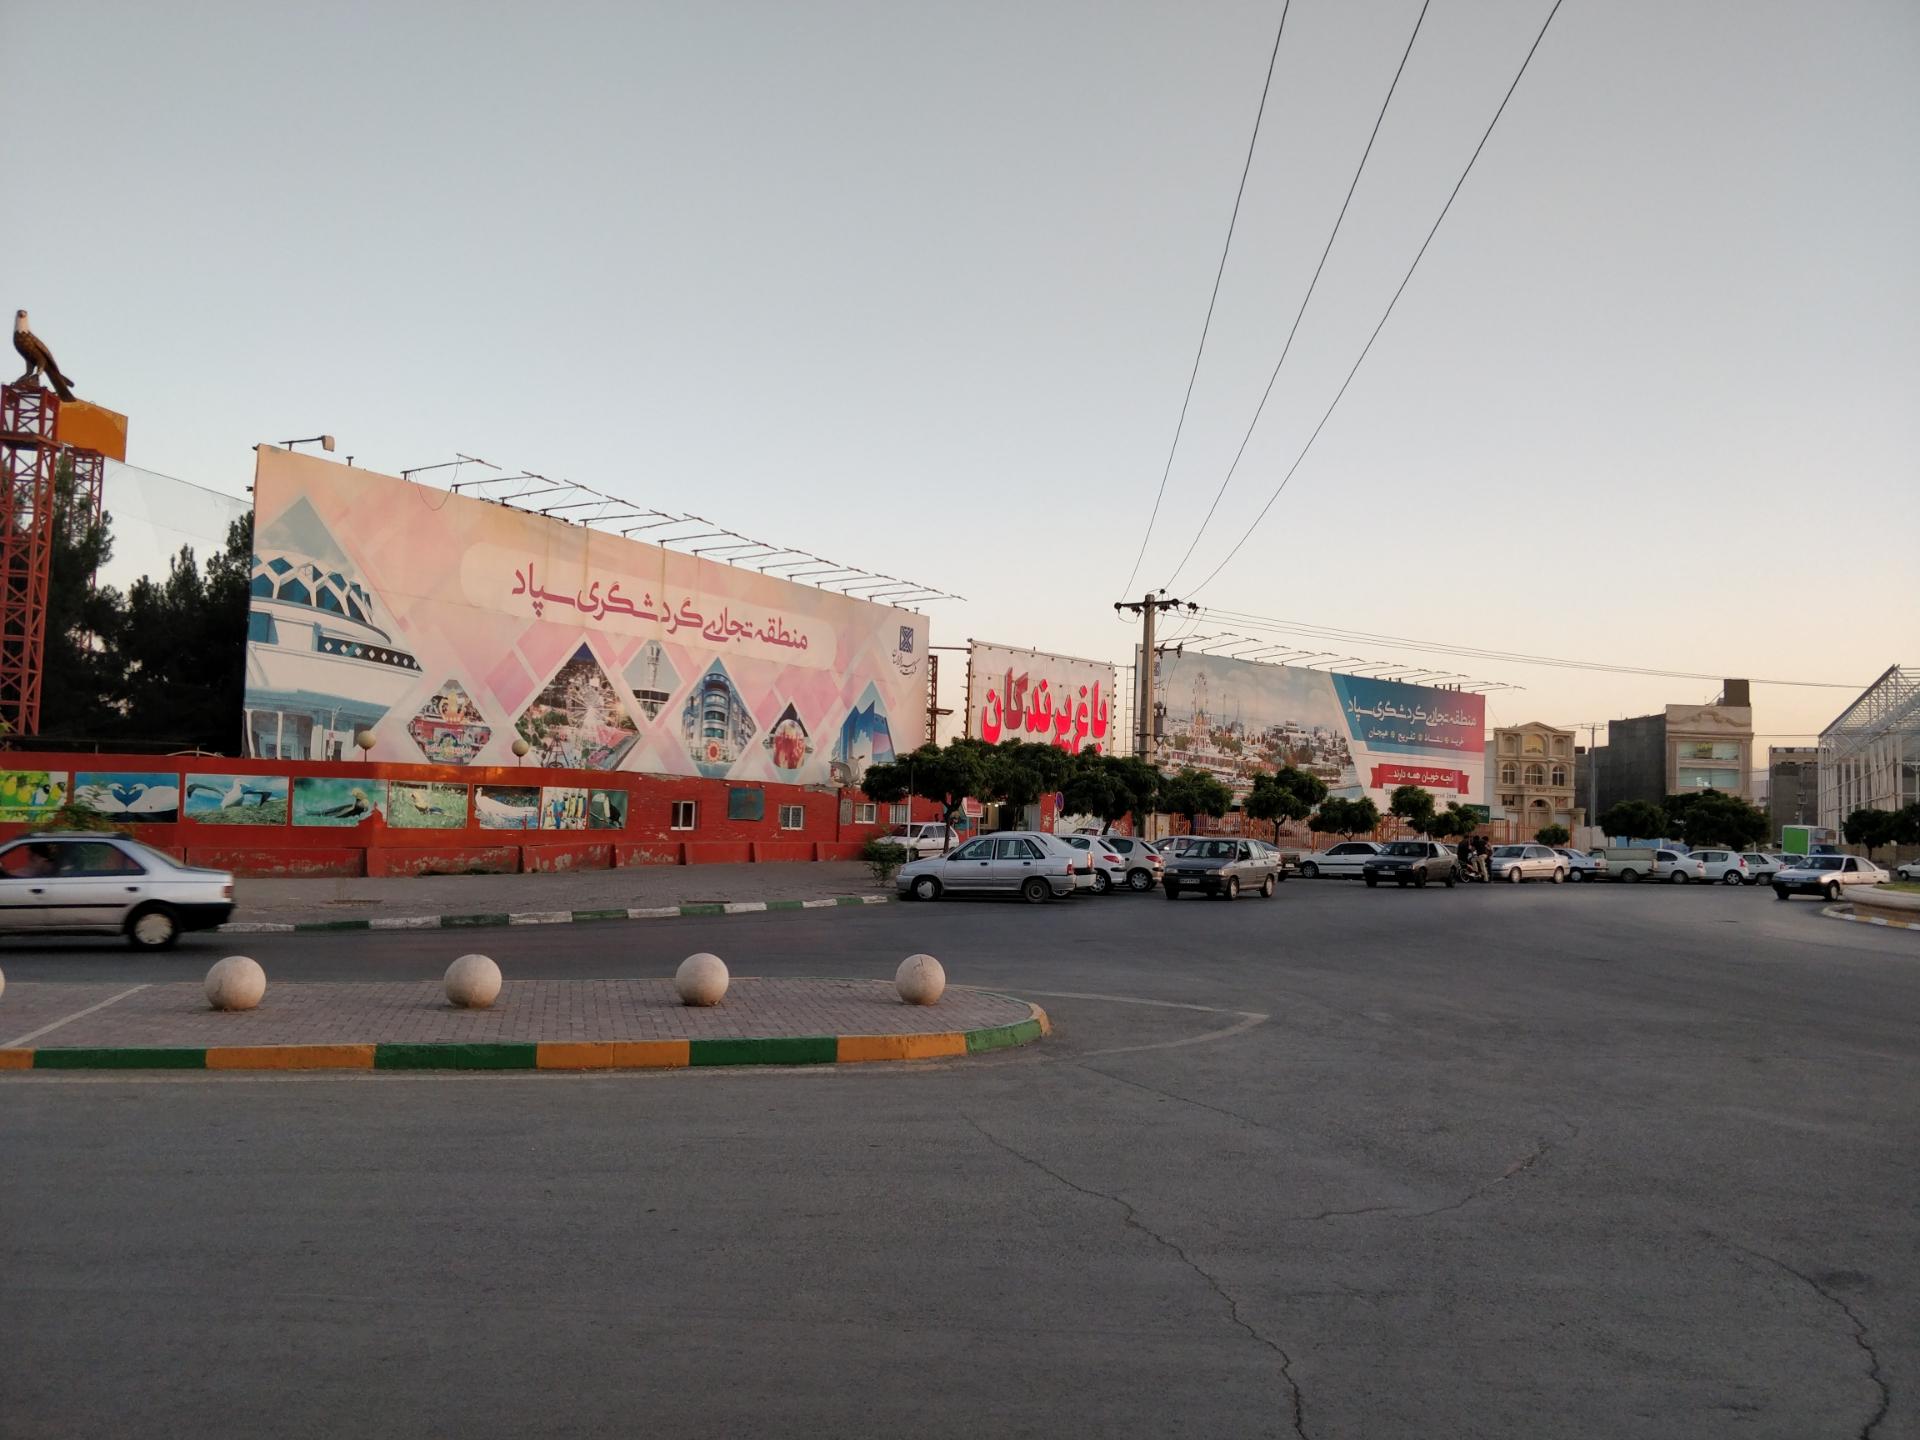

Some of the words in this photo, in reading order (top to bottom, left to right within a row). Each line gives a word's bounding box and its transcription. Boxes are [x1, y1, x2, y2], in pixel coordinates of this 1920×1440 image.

[512, 562, 575, 617] سپاد
[576, 580, 703, 634] گردشگری
[702, 607, 752, 643] تجاری
[754, 617, 808, 650] منطقه
[1071, 680, 1107, 756] باغ
[1347, 696, 1374, 721] سپاد
[1448, 709, 1477, 726] منطقه
[1407, 771, 1421, 779] همه
